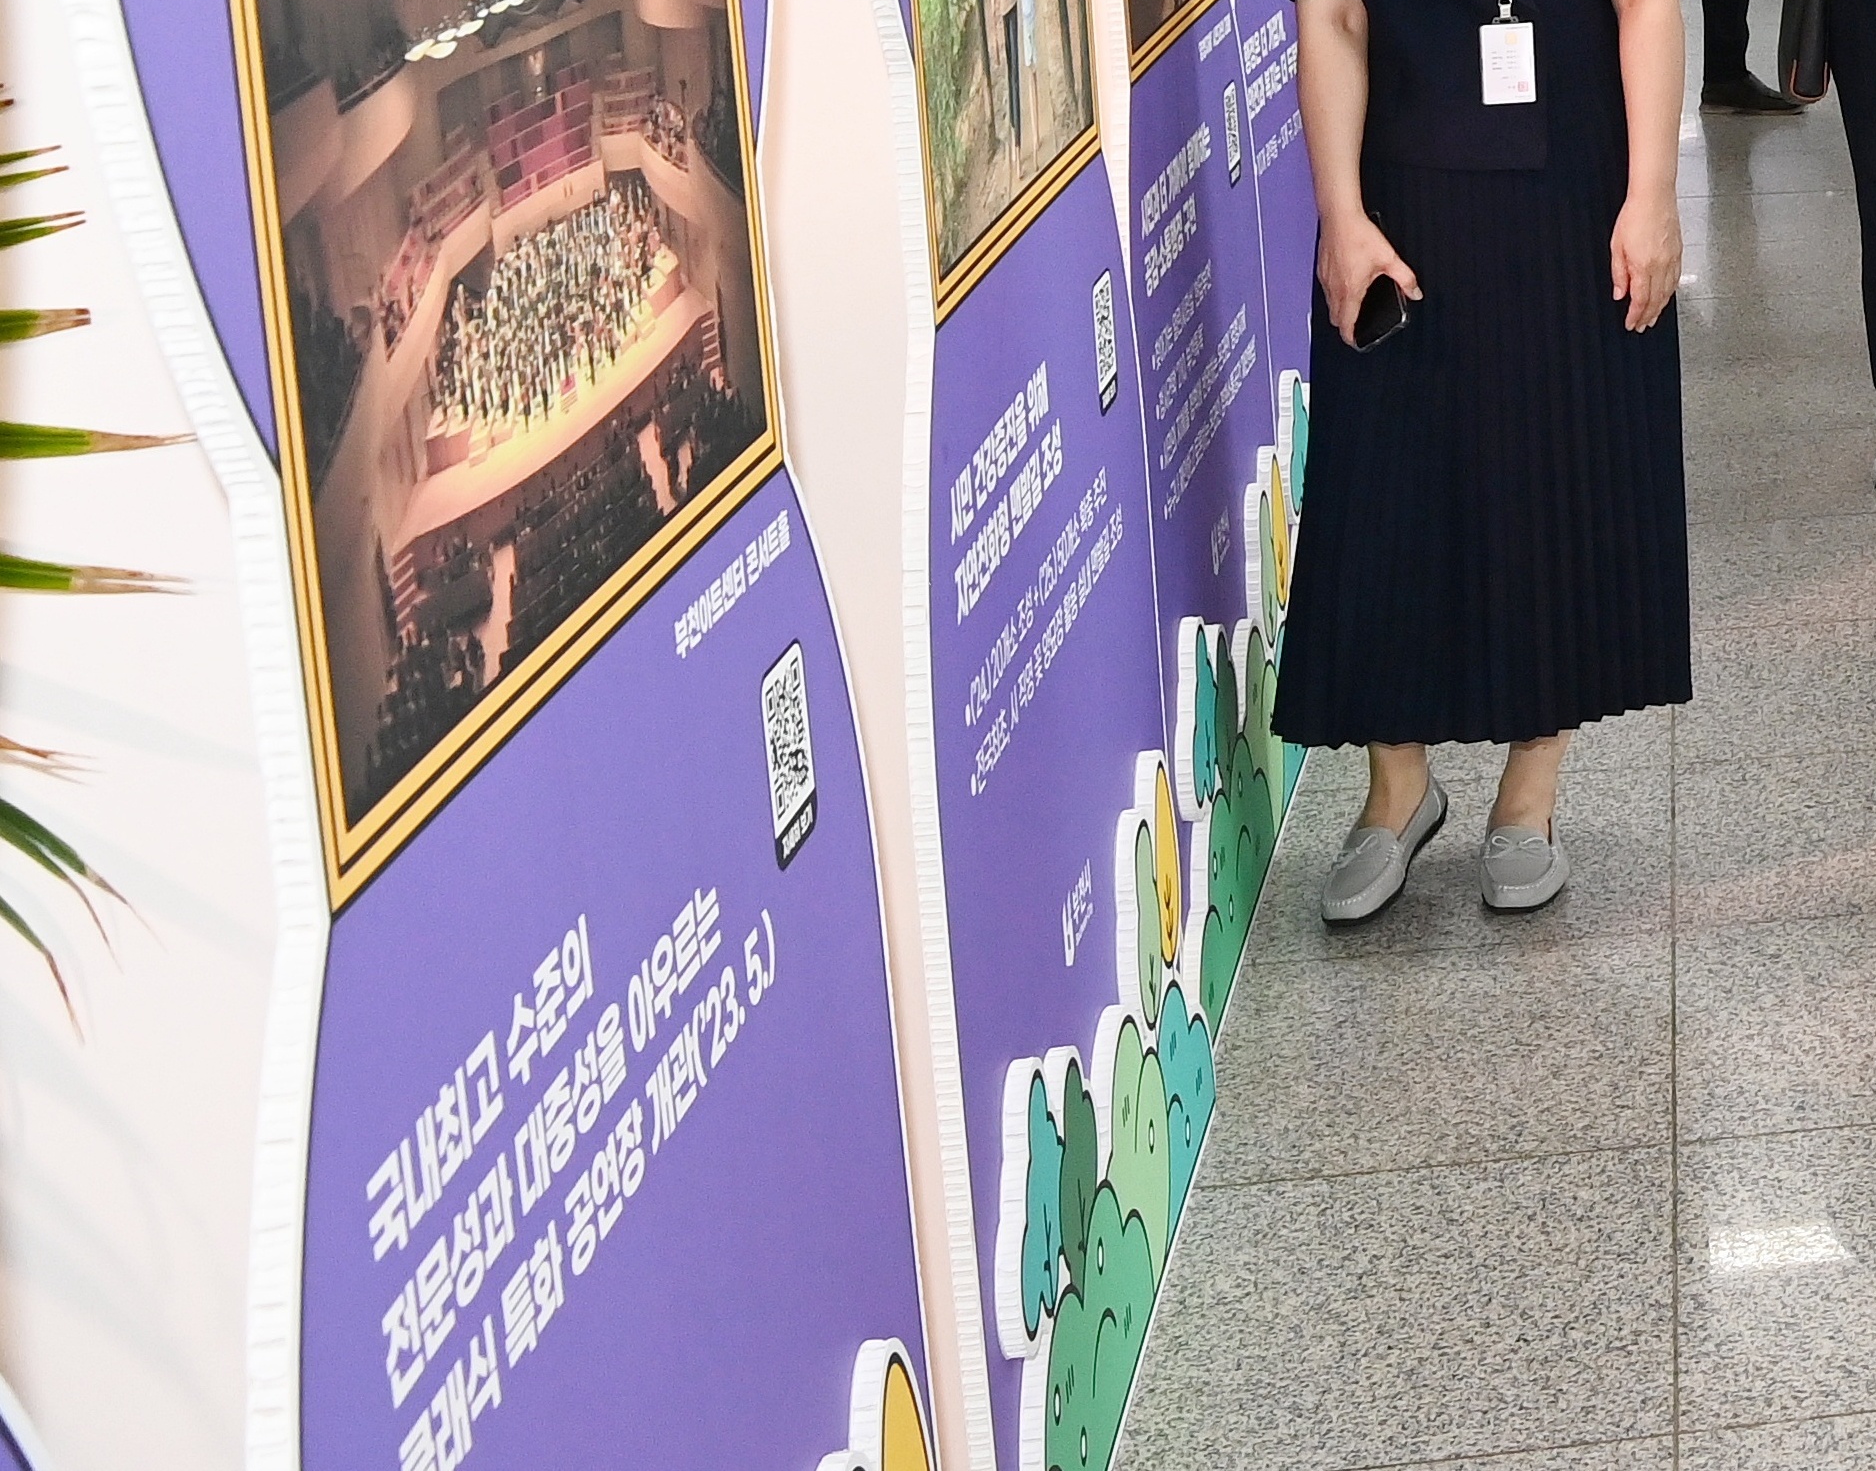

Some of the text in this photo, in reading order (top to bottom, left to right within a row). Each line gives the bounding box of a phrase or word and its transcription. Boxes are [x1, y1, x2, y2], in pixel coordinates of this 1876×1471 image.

[951, 360, 1050, 546] 시민 건강증진을 위해
[954, 418, 1063, 627] 자연친화형 맨발길 조성
[674, 509, 792, 659] 부천아트센터 콘서트홀
[367, 913, 594, 1261] 국내최고 수준의
[382, 887, 721, 1409] 전문성과 대중성을 아우르는
[501, 1219, 565, 1369] 특화
[564, 1098, 645, 1277] 공연장
